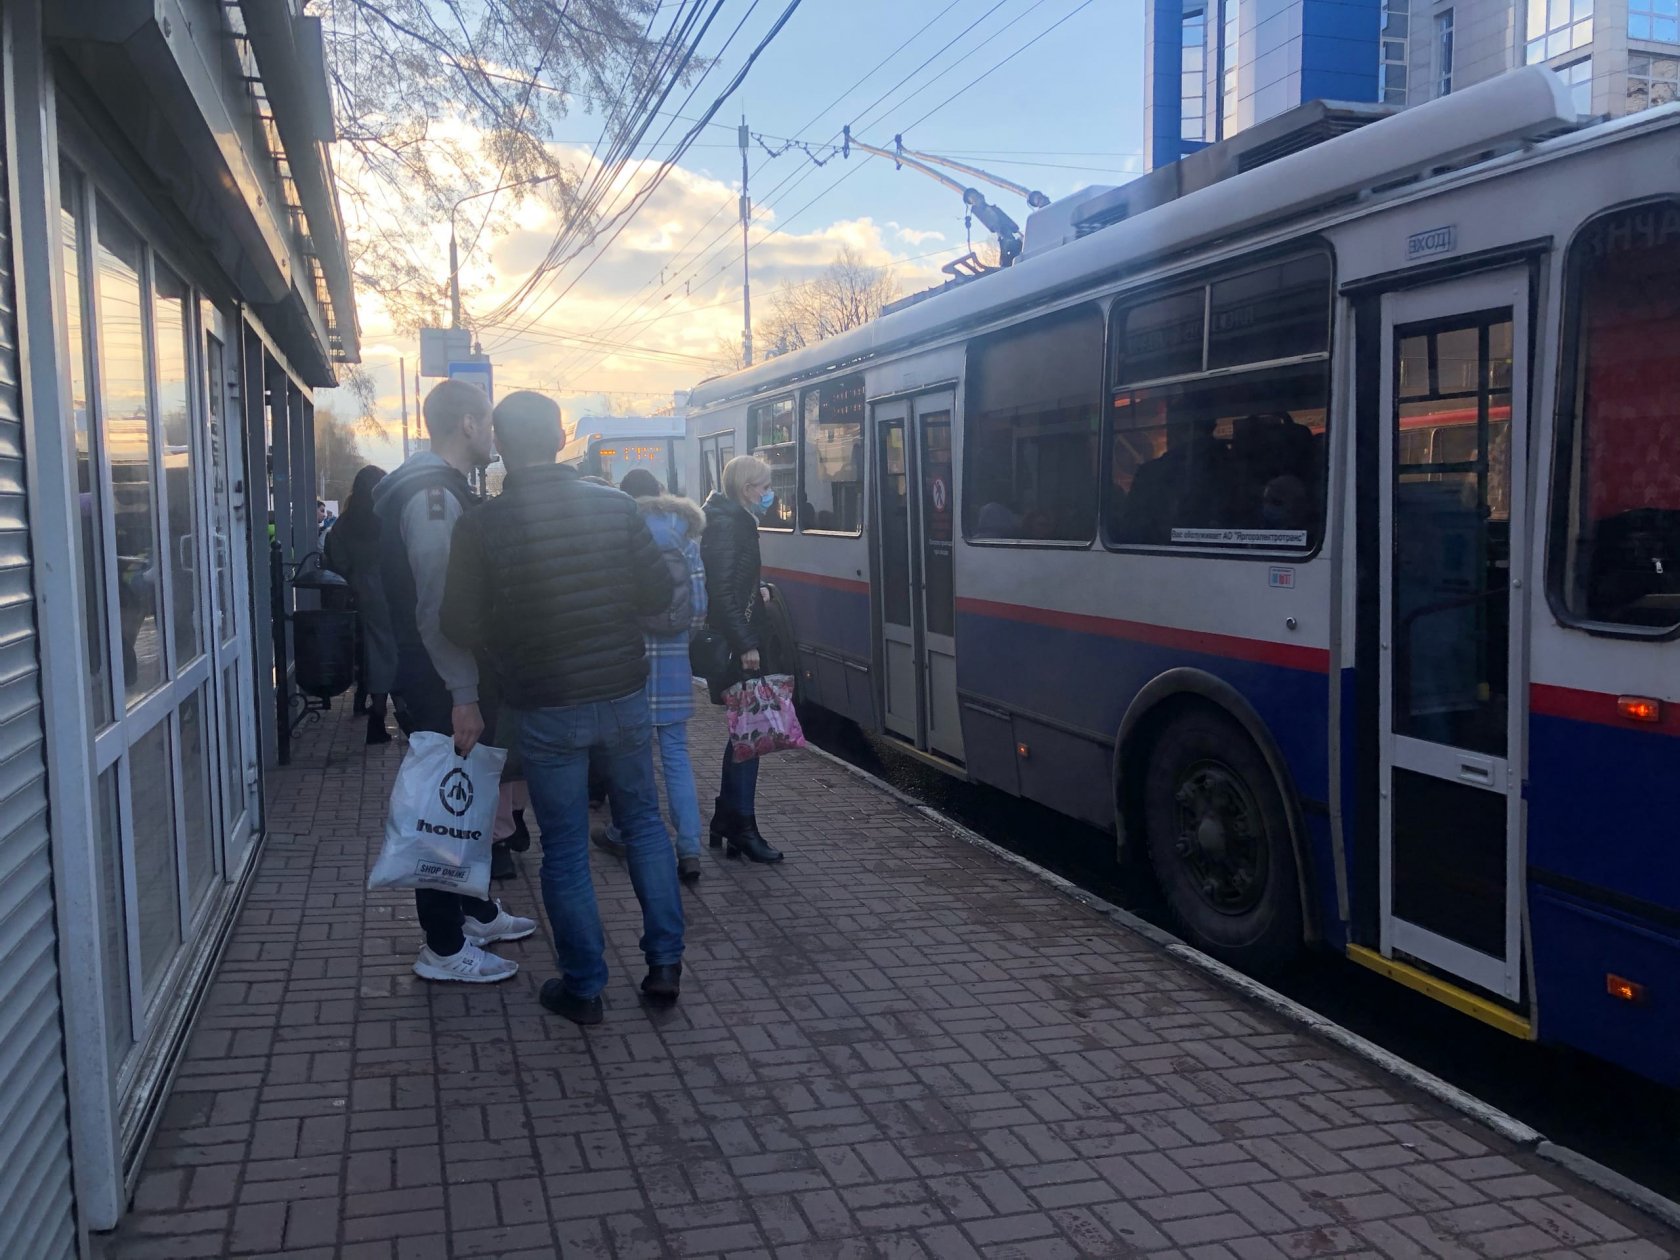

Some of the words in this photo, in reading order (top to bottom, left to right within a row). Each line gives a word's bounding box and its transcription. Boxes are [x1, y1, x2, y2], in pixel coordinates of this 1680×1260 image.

[1408, 231, 1447, 254] ВХОД
[416, 819, 482, 841] house
[420, 863, 442, 875] SHOP
[442, 868, 466, 879] ONLINE
